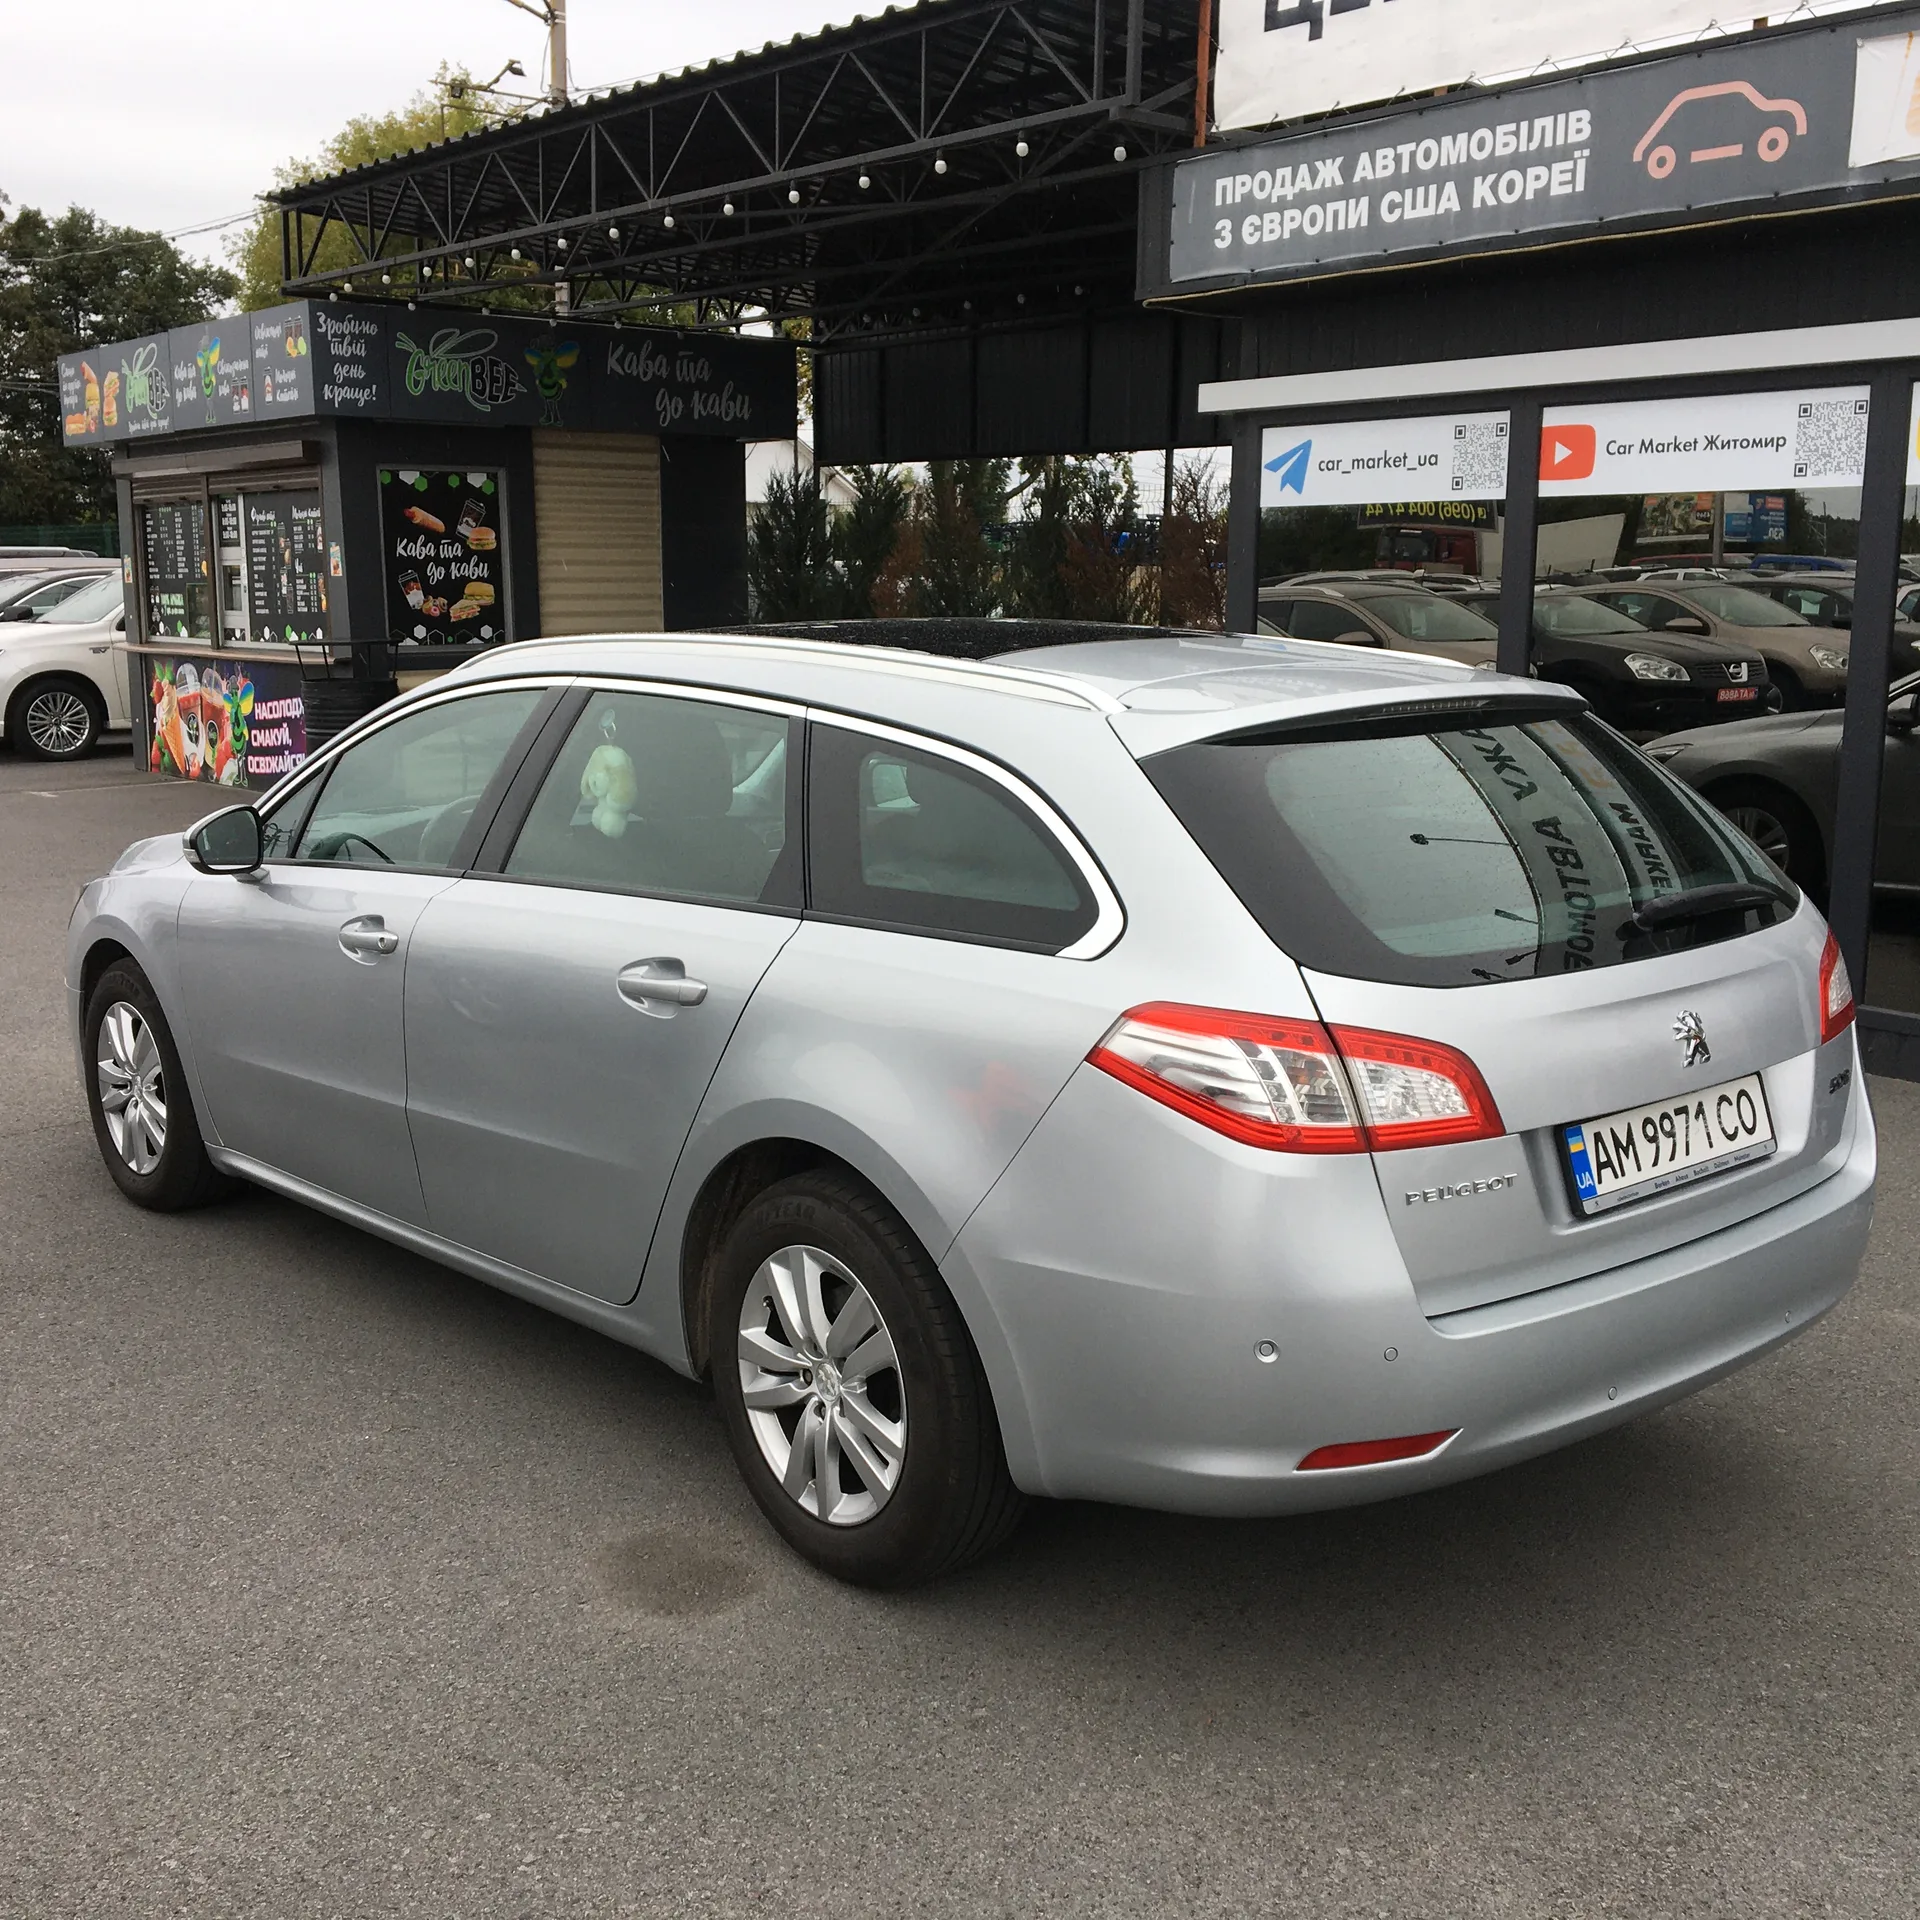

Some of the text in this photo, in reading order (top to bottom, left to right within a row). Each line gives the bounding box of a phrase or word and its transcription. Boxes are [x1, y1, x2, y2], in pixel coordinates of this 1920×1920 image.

[1215, 108, 1592, 206] ПРОДАЖ АВТОМОБІЛІВ
[1214, 149, 1591, 249] З ЄВРОПИ США КОРЕЇ
[333, 361, 366, 383] день
[607, 339, 713, 383] Кава та
[322, 384, 377, 408] краще!
[655, 380, 752, 427] до кави
[1606, 433, 1787, 456] Car Market Житомир
[1318, 449, 1439, 475] car_market_ua
[396, 534, 464, 560] Кава та
[426, 555, 490, 585] до кави
[251, 722, 293, 747] СМАКУЙ,
[1593, 1088, 1757, 1185] AM 9971 CO
[1405, 1173, 1518, 1204] PEUGEOT
[1576, 1171, 1594, 1189] UA
